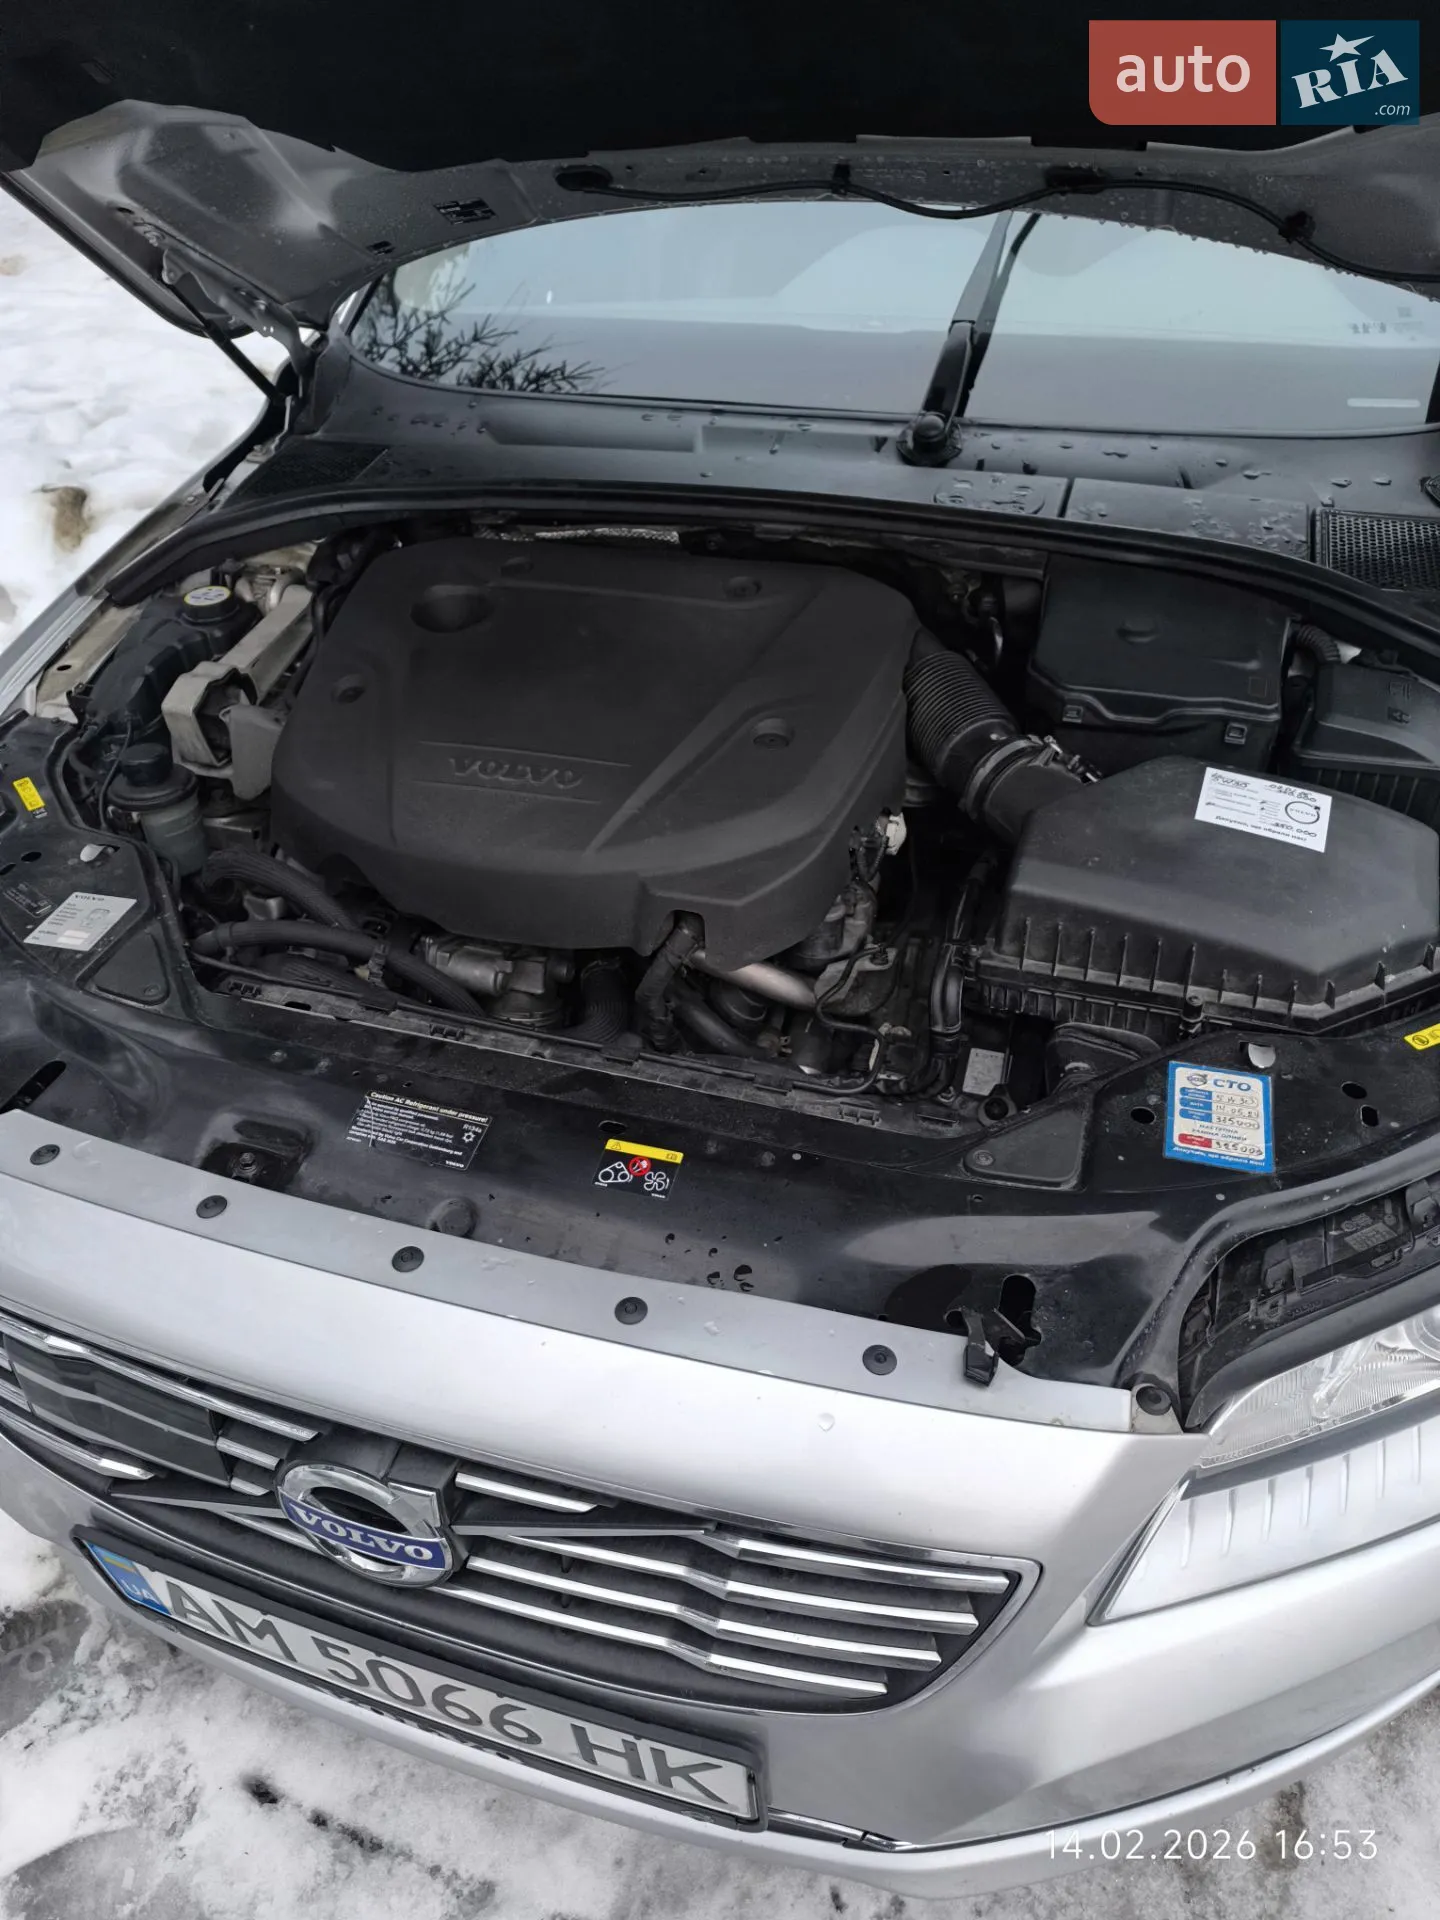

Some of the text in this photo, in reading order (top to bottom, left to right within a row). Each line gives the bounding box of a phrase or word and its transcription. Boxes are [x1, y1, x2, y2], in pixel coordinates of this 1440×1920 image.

[449, 757, 585, 789] VOLVO
[1213, 1078, 1251, 1091] СТО
[371, 1091, 395, 1101] Caution
[405, 1099, 440, 1112] Refrigerant
[439, 1107, 459, 1116] under
[458, 1112, 489, 1123] pressure!
[289, 1504, 434, 1562] VOLVO
[123, 1578, 152, 1601] UA
[165, 1580, 298, 1664] AM
[310, 1636, 542, 1745] 5066
[570, 1723, 729, 1804] HK
